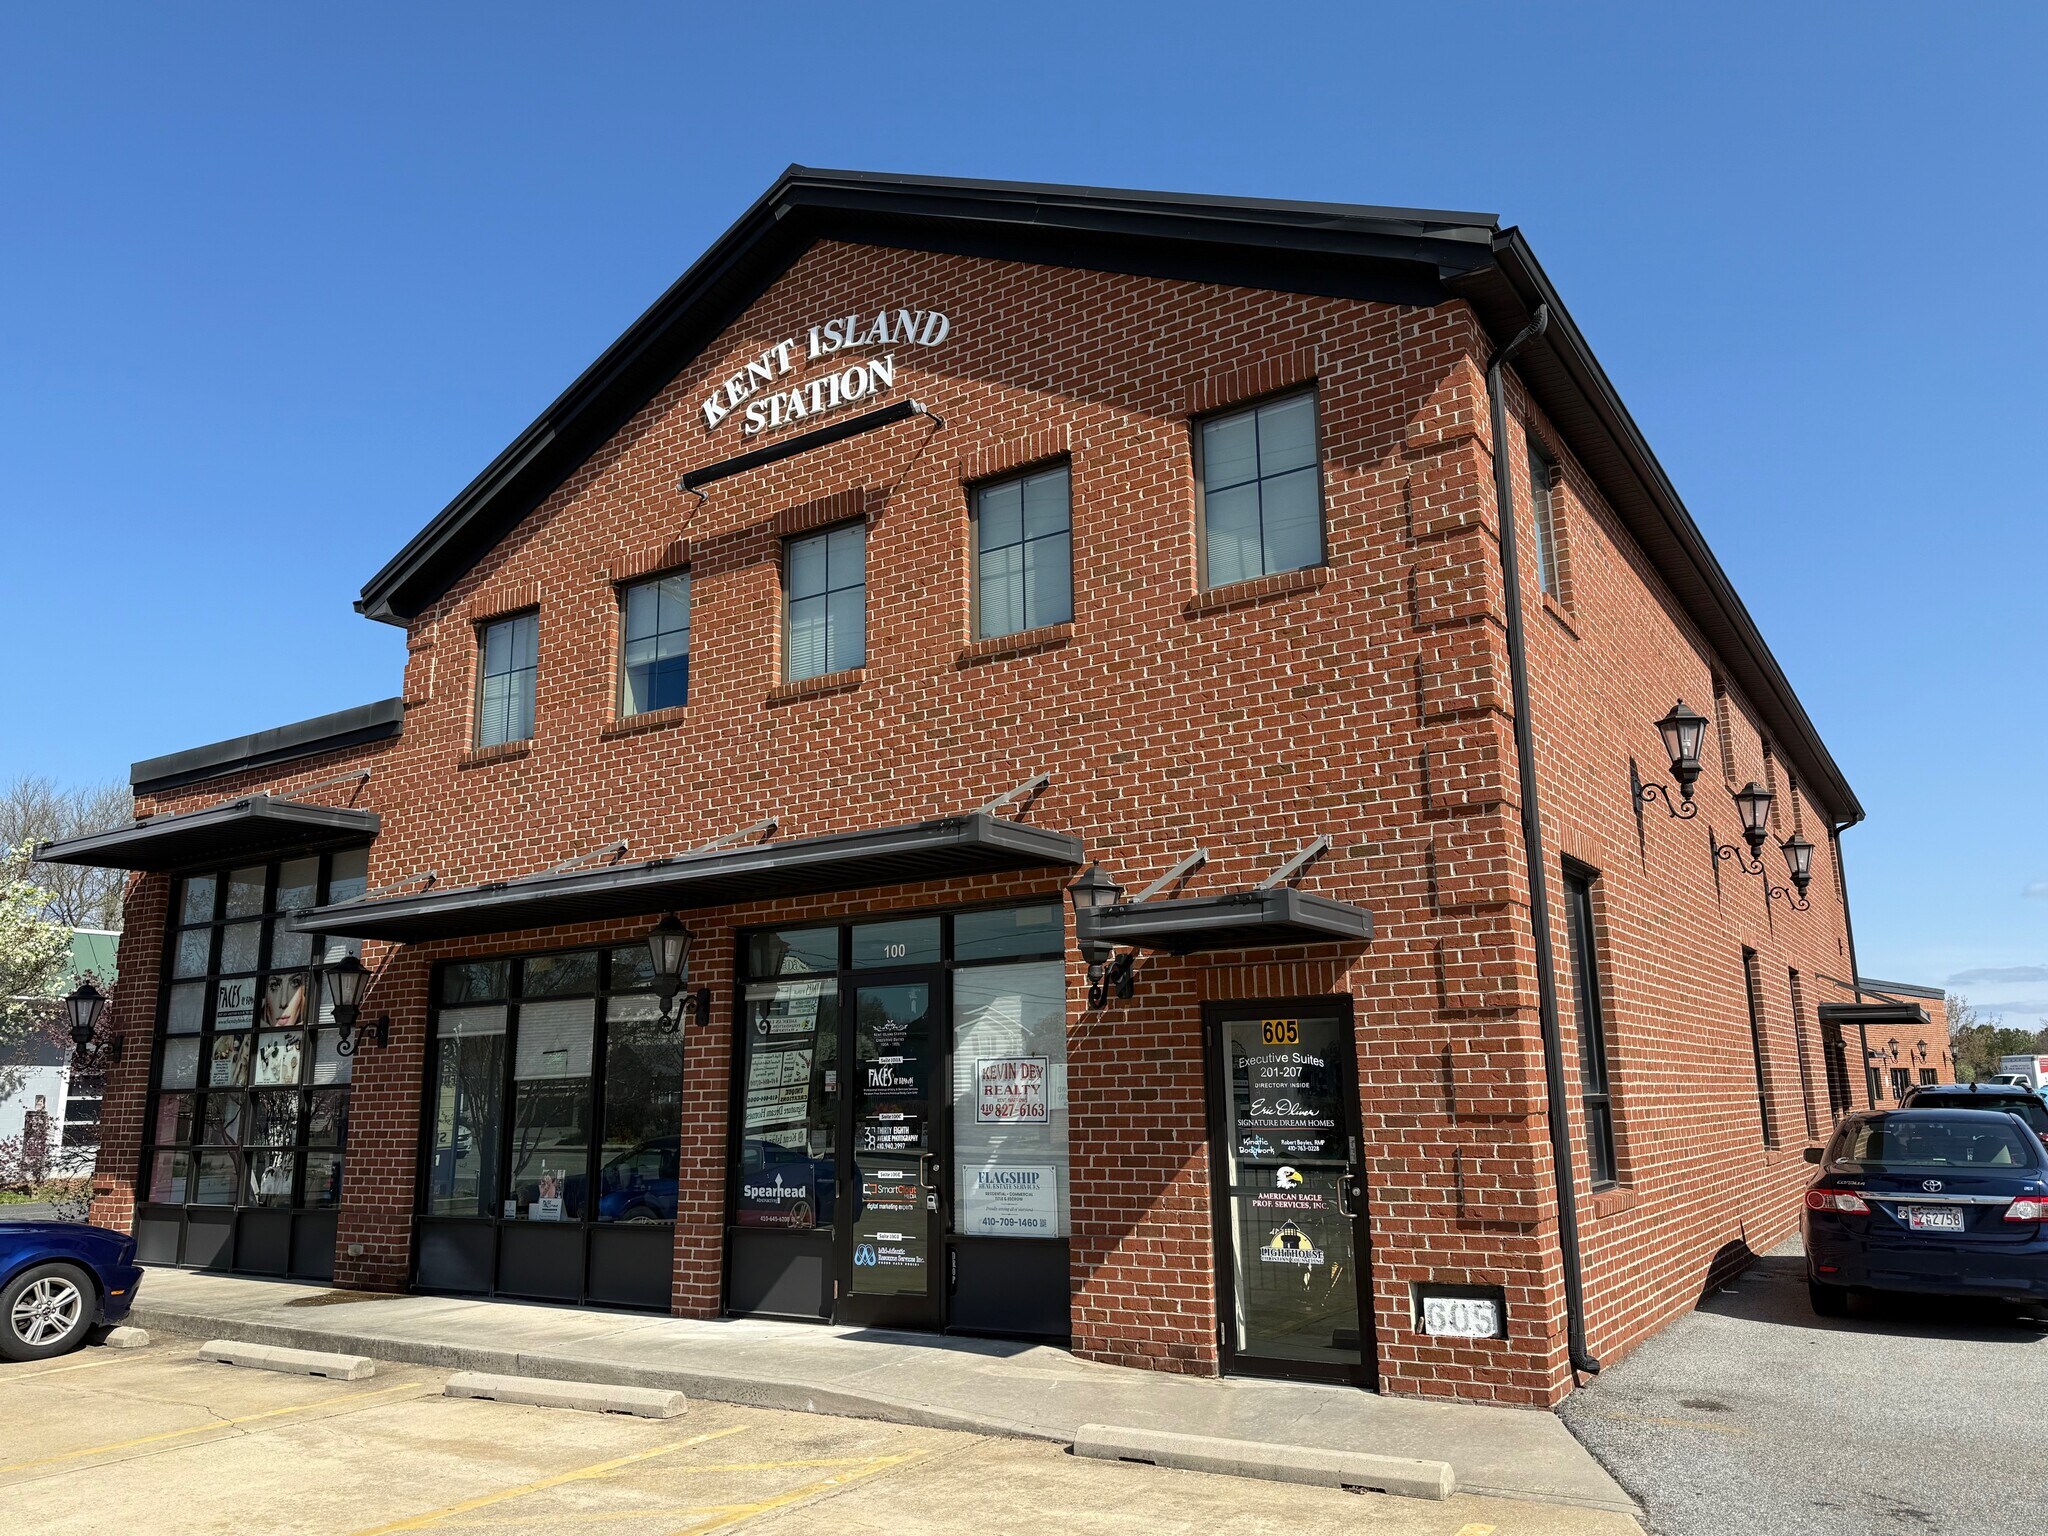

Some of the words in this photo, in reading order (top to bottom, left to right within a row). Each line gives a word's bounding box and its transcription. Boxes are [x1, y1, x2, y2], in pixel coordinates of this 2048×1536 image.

[701, 337, 794, 429] KENT
[806, 309, 950, 360] ISLAND
[745, 354, 895, 436] STATION
[884, 944, 906, 958] 100
[219, 985, 242, 1008] FACES
[1263, 1021, 1297, 1044] 605
[1238, 1052, 1289, 1068] Executive
[1292, 1052, 1325, 1068] Suites
[868, 1067, 893, 1087] FACES
[982, 1062, 1017, 1080] KEVIN
[1021, 1063, 1044, 1079] DEY
[1260, 1066, 1303, 1078] 201-207
[984, 1085, 1041, 1095] REALTY
[981, 1103, 994, 1112] 410
[995, 1103, 1044, 1117] 827-6163
[1250, 1098, 1276, 1116] Eric
[1276, 1098, 1320, 1117] Oliver
[1237, 1119, 1278, 1127] SIGNATURE
[1279, 1119, 1307, 1127] DREAM
[1308, 1119, 1335, 1127] HOMES
[877, 1126, 892, 1135] THIRTY
[893, 1126, 910, 1134] EIGHTH
[891, 1134, 919, 1142] PHOTOGRAPHY
[1238, 1145, 1275, 1155] Bodywork
[978, 1171, 1040, 1184] FLAGSHIP
[744, 1184, 806, 1200] Spearhead
[878, 1184, 917, 1195] SmartClout
[1257, 1193, 1298, 1201] AMERICAN
[1298, 1194, 1323, 1202] EAGLE
[866, 1203, 879, 1211] digital
[879, 1203, 898, 1212] marketing
[1252, 1200, 1274, 1208] PROF.
[1274, 1200, 1312, 1209] SERVICES,
[1313, 1202, 1330, 1210] INC.
[982, 1217, 1038, 1227] 410-709-1460
[1261, 1247, 1324, 1259] LIGHTHOUSE
[1427, 1301, 1494, 1333] 605
